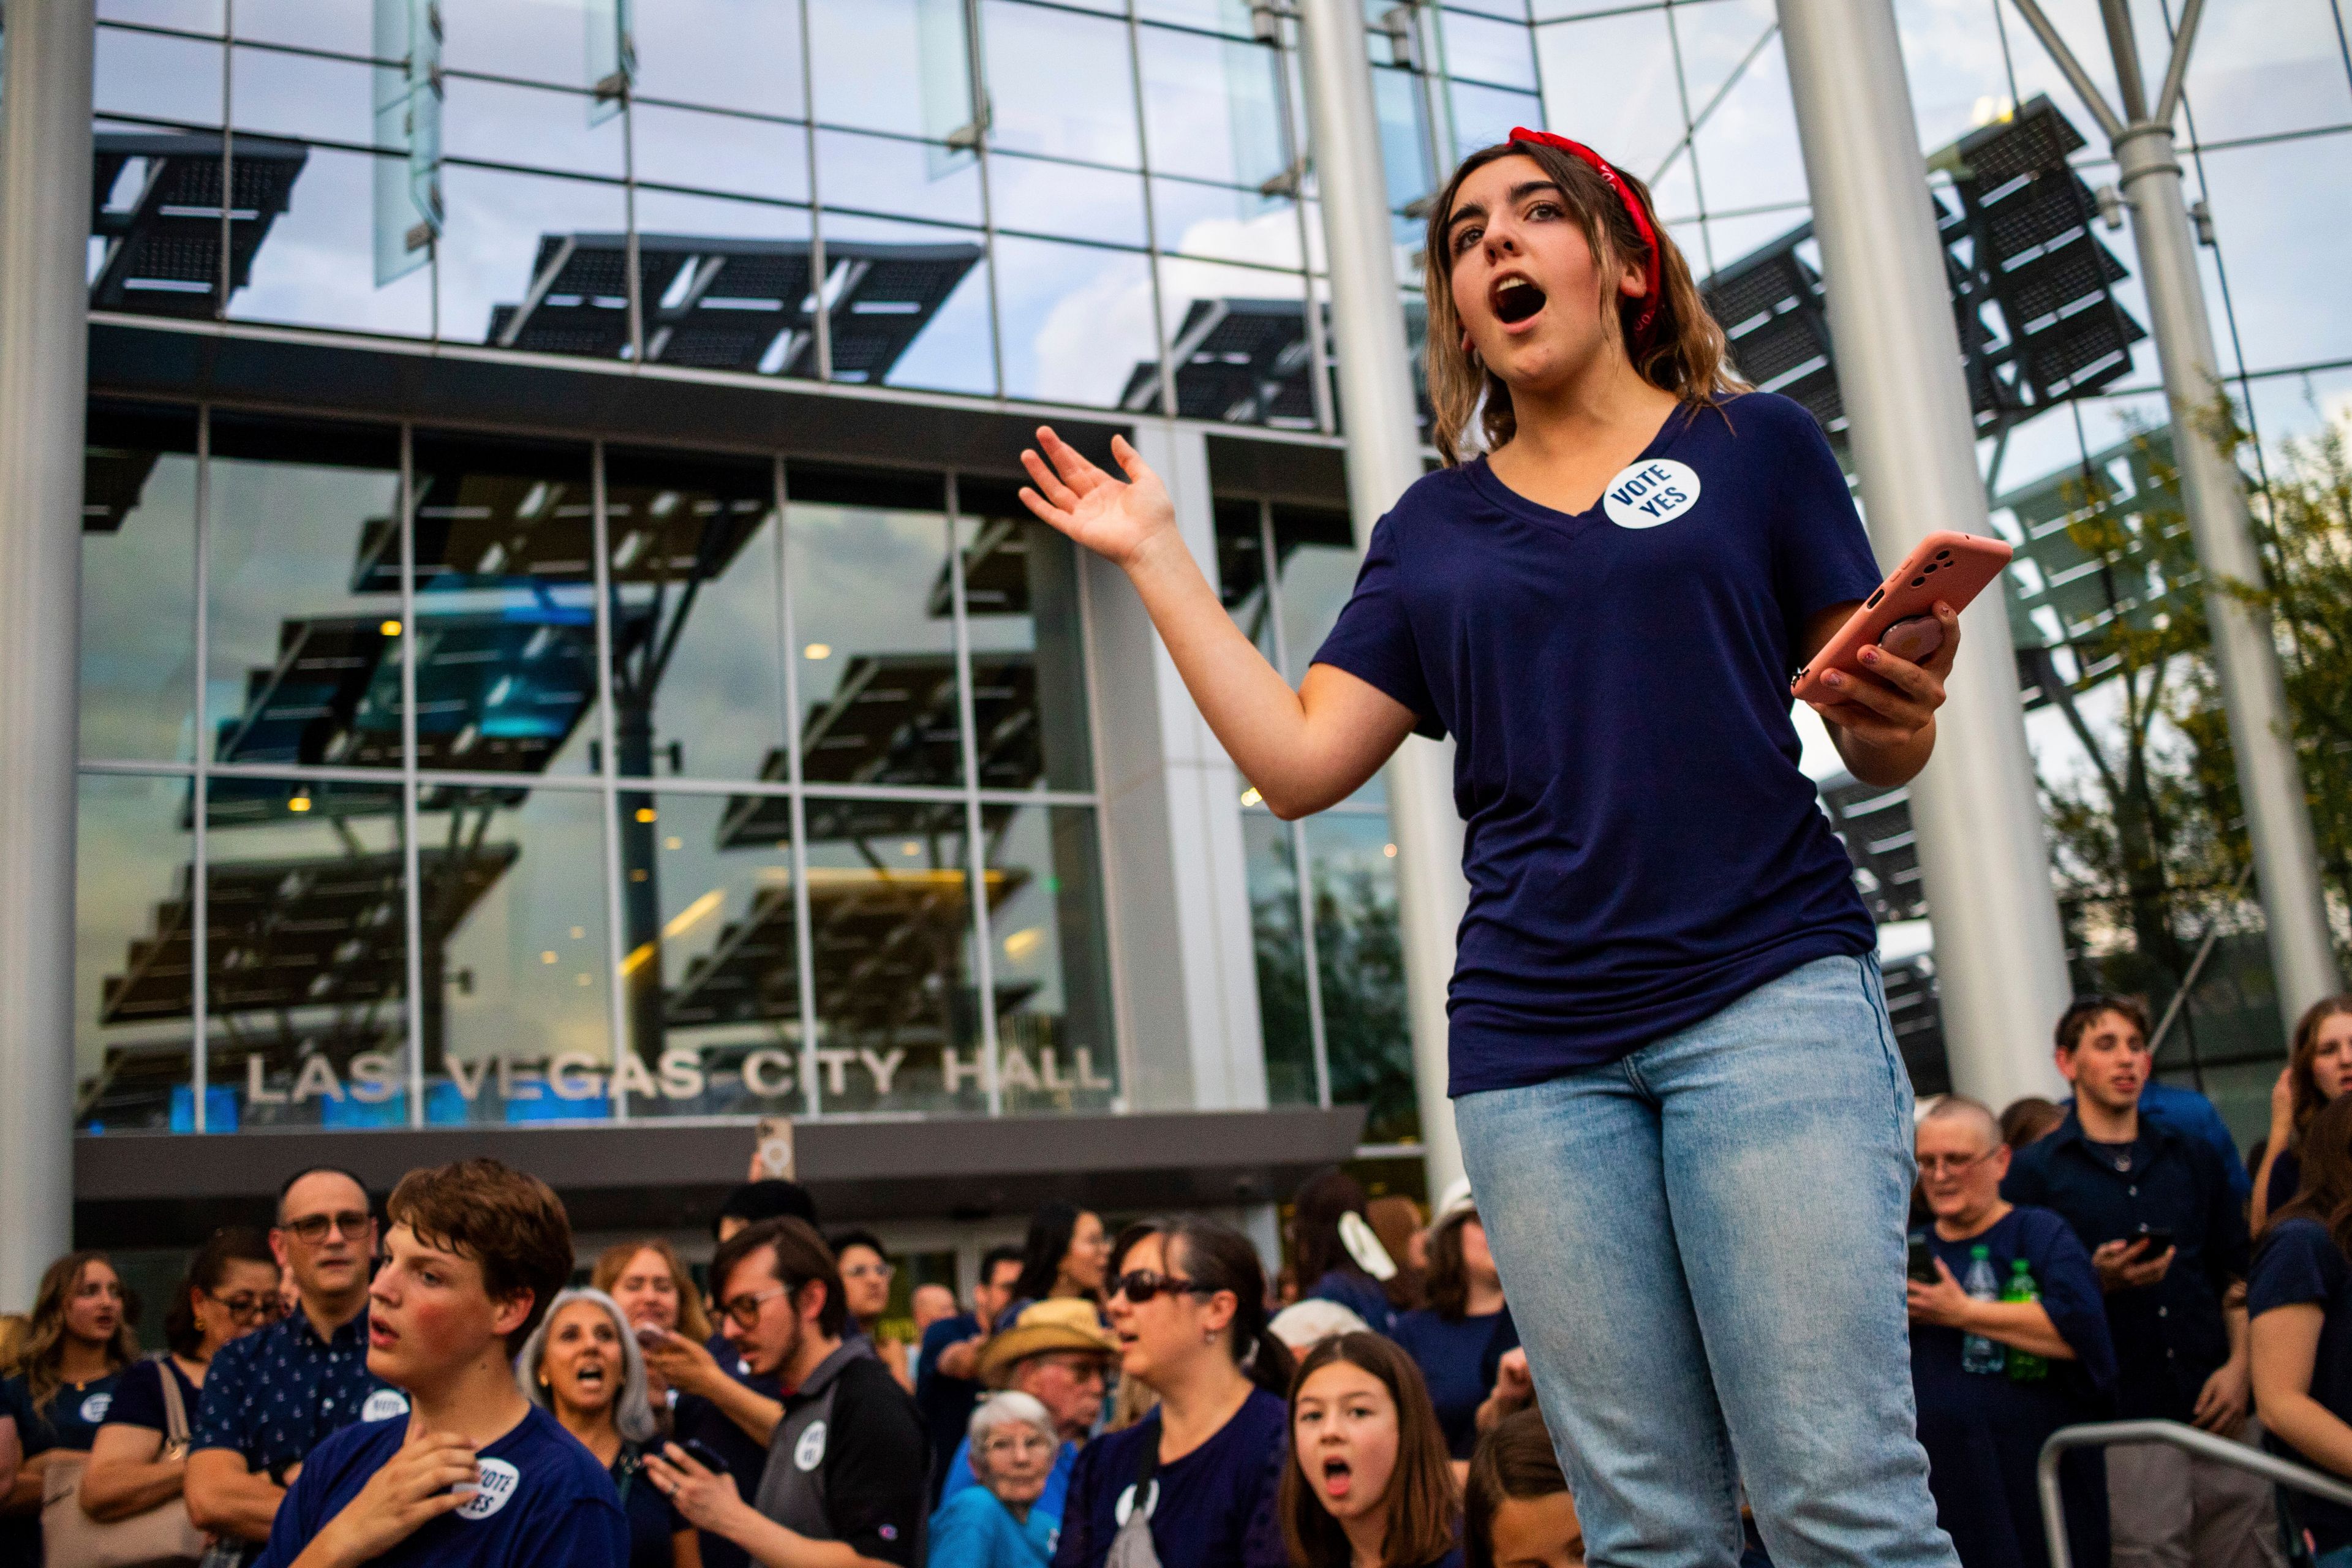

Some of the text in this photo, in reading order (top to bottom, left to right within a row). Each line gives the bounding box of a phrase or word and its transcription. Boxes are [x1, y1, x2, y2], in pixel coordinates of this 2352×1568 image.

[1610, 464, 1672, 506] VOTE
[1639, 486, 1687, 518] YES
[247, 1045, 1112, 1102] LAS VEGAS CITY HALL
